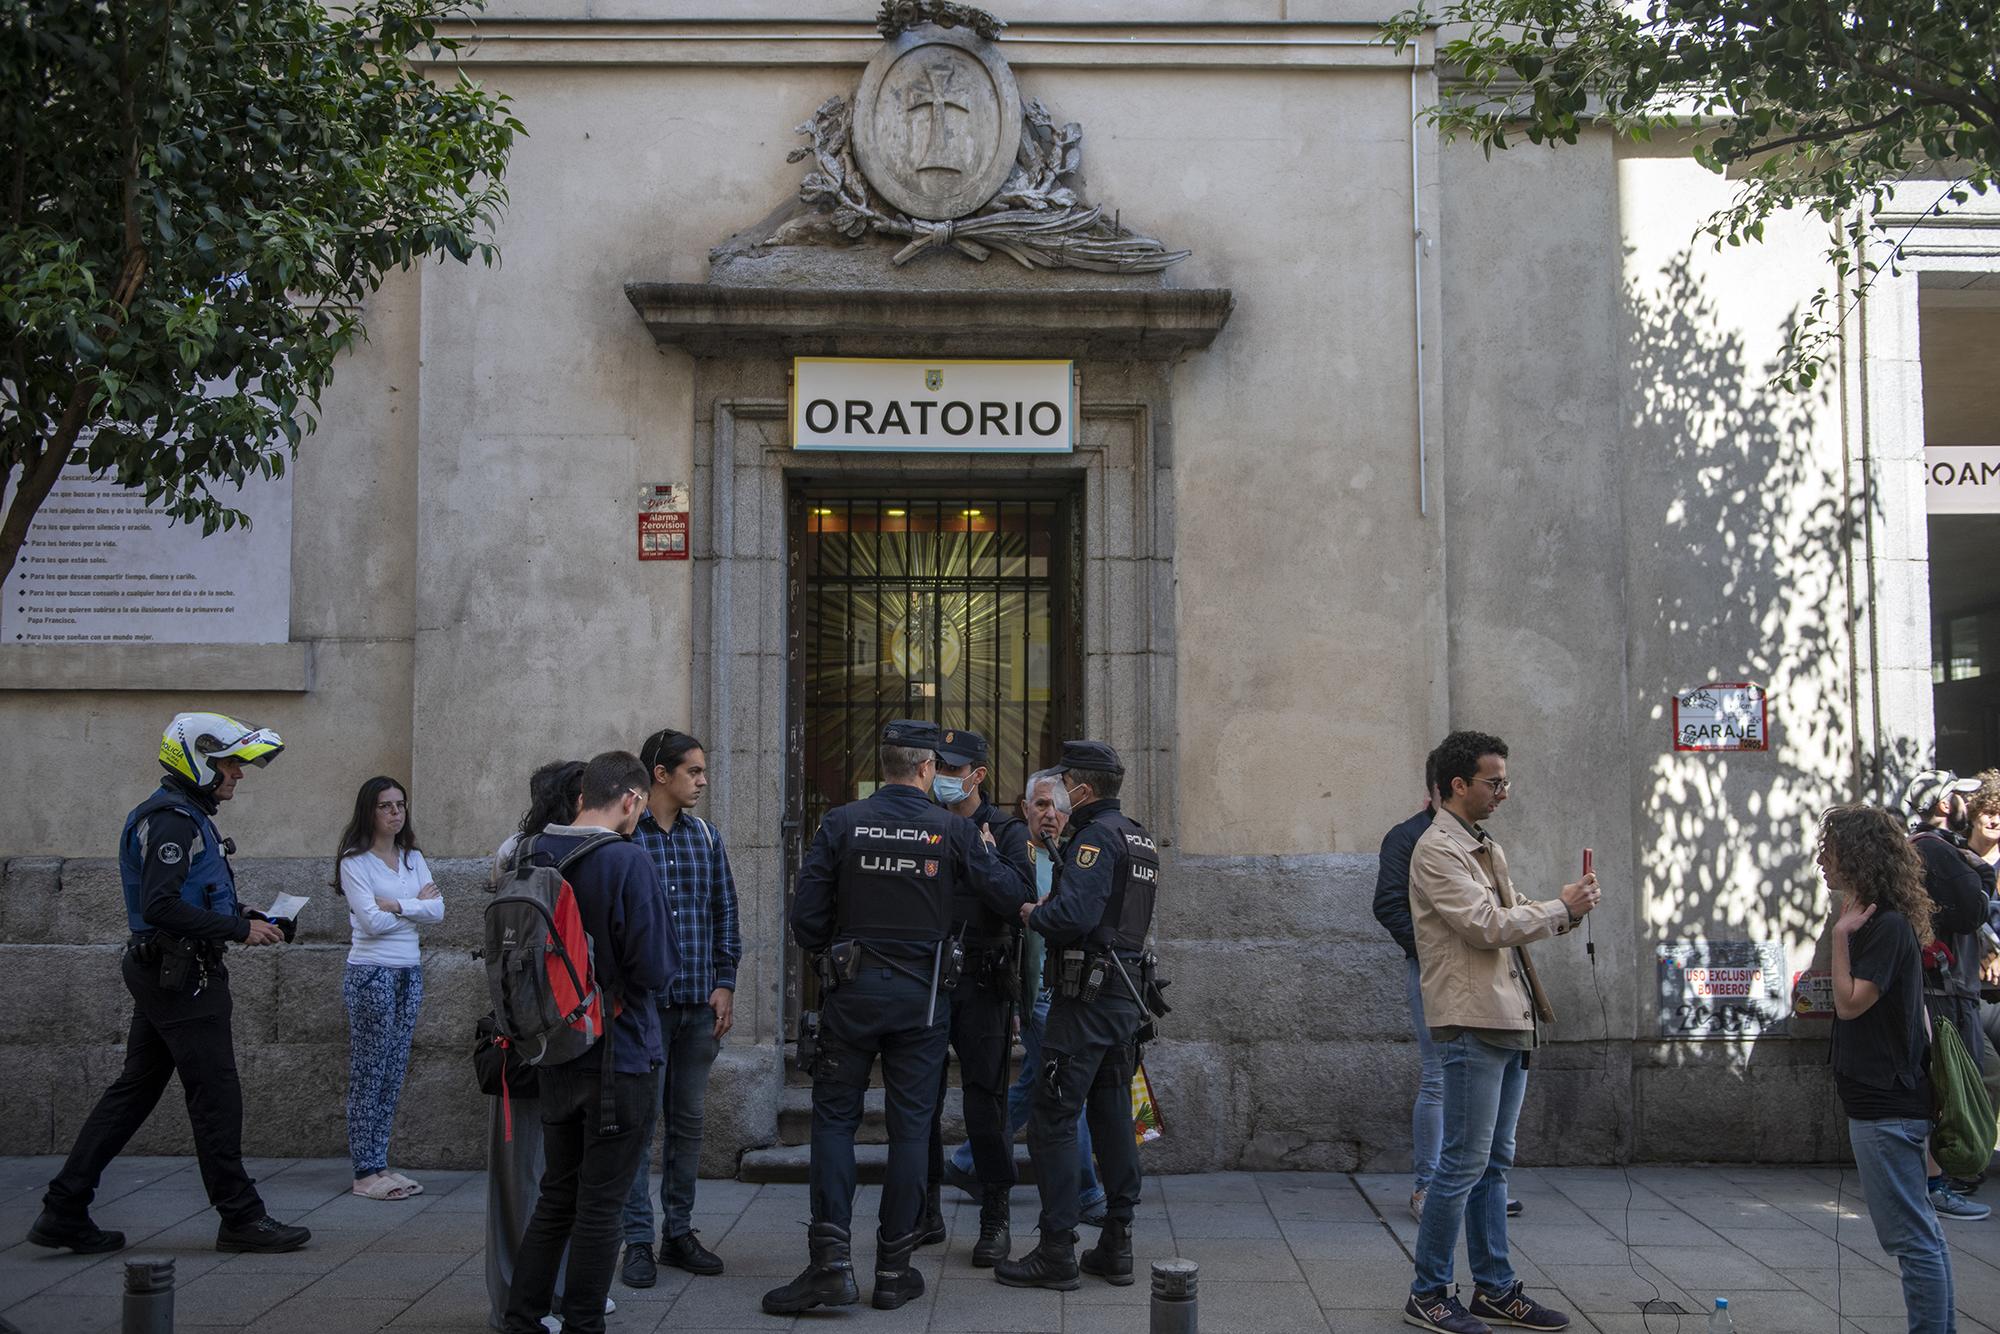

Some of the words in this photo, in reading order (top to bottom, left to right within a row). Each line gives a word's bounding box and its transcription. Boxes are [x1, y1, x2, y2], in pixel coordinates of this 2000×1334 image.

[805, 399, 1062, 436] ORATORIO
[1924, 462, 2000, 486] OAM
[642, 521, 686, 529] Zerovision
[1684, 724, 1757, 738] GARAJE
[854, 826, 930, 842] POLICIA
[860, 856, 920, 874] U.I.P.
[1686, 970, 1706, 982] USO
[1709, 970, 1761, 982] EXCLUSIVO
[1698, 984, 1750, 995] BOMBEROS
